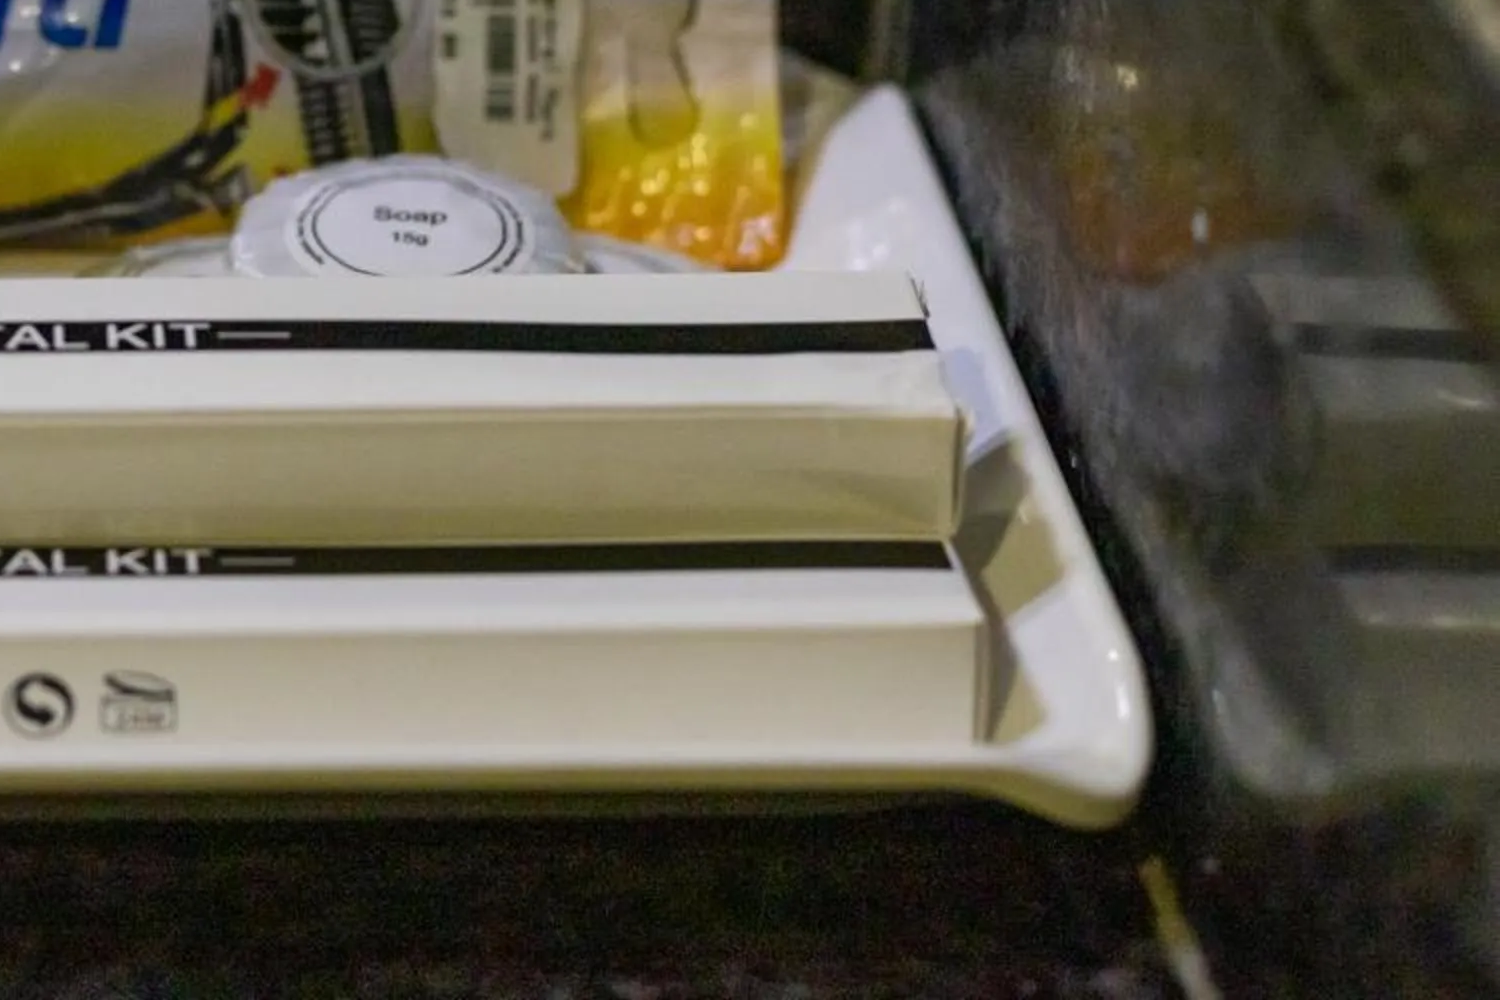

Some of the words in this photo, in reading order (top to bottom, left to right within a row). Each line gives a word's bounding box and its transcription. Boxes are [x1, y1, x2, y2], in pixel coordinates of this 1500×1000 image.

[373, 205, 448, 226] Soap
[392, 230, 430, 247] 15g
[105, 321, 211, 351] KIT
[104, 548, 213, 576] KIT
